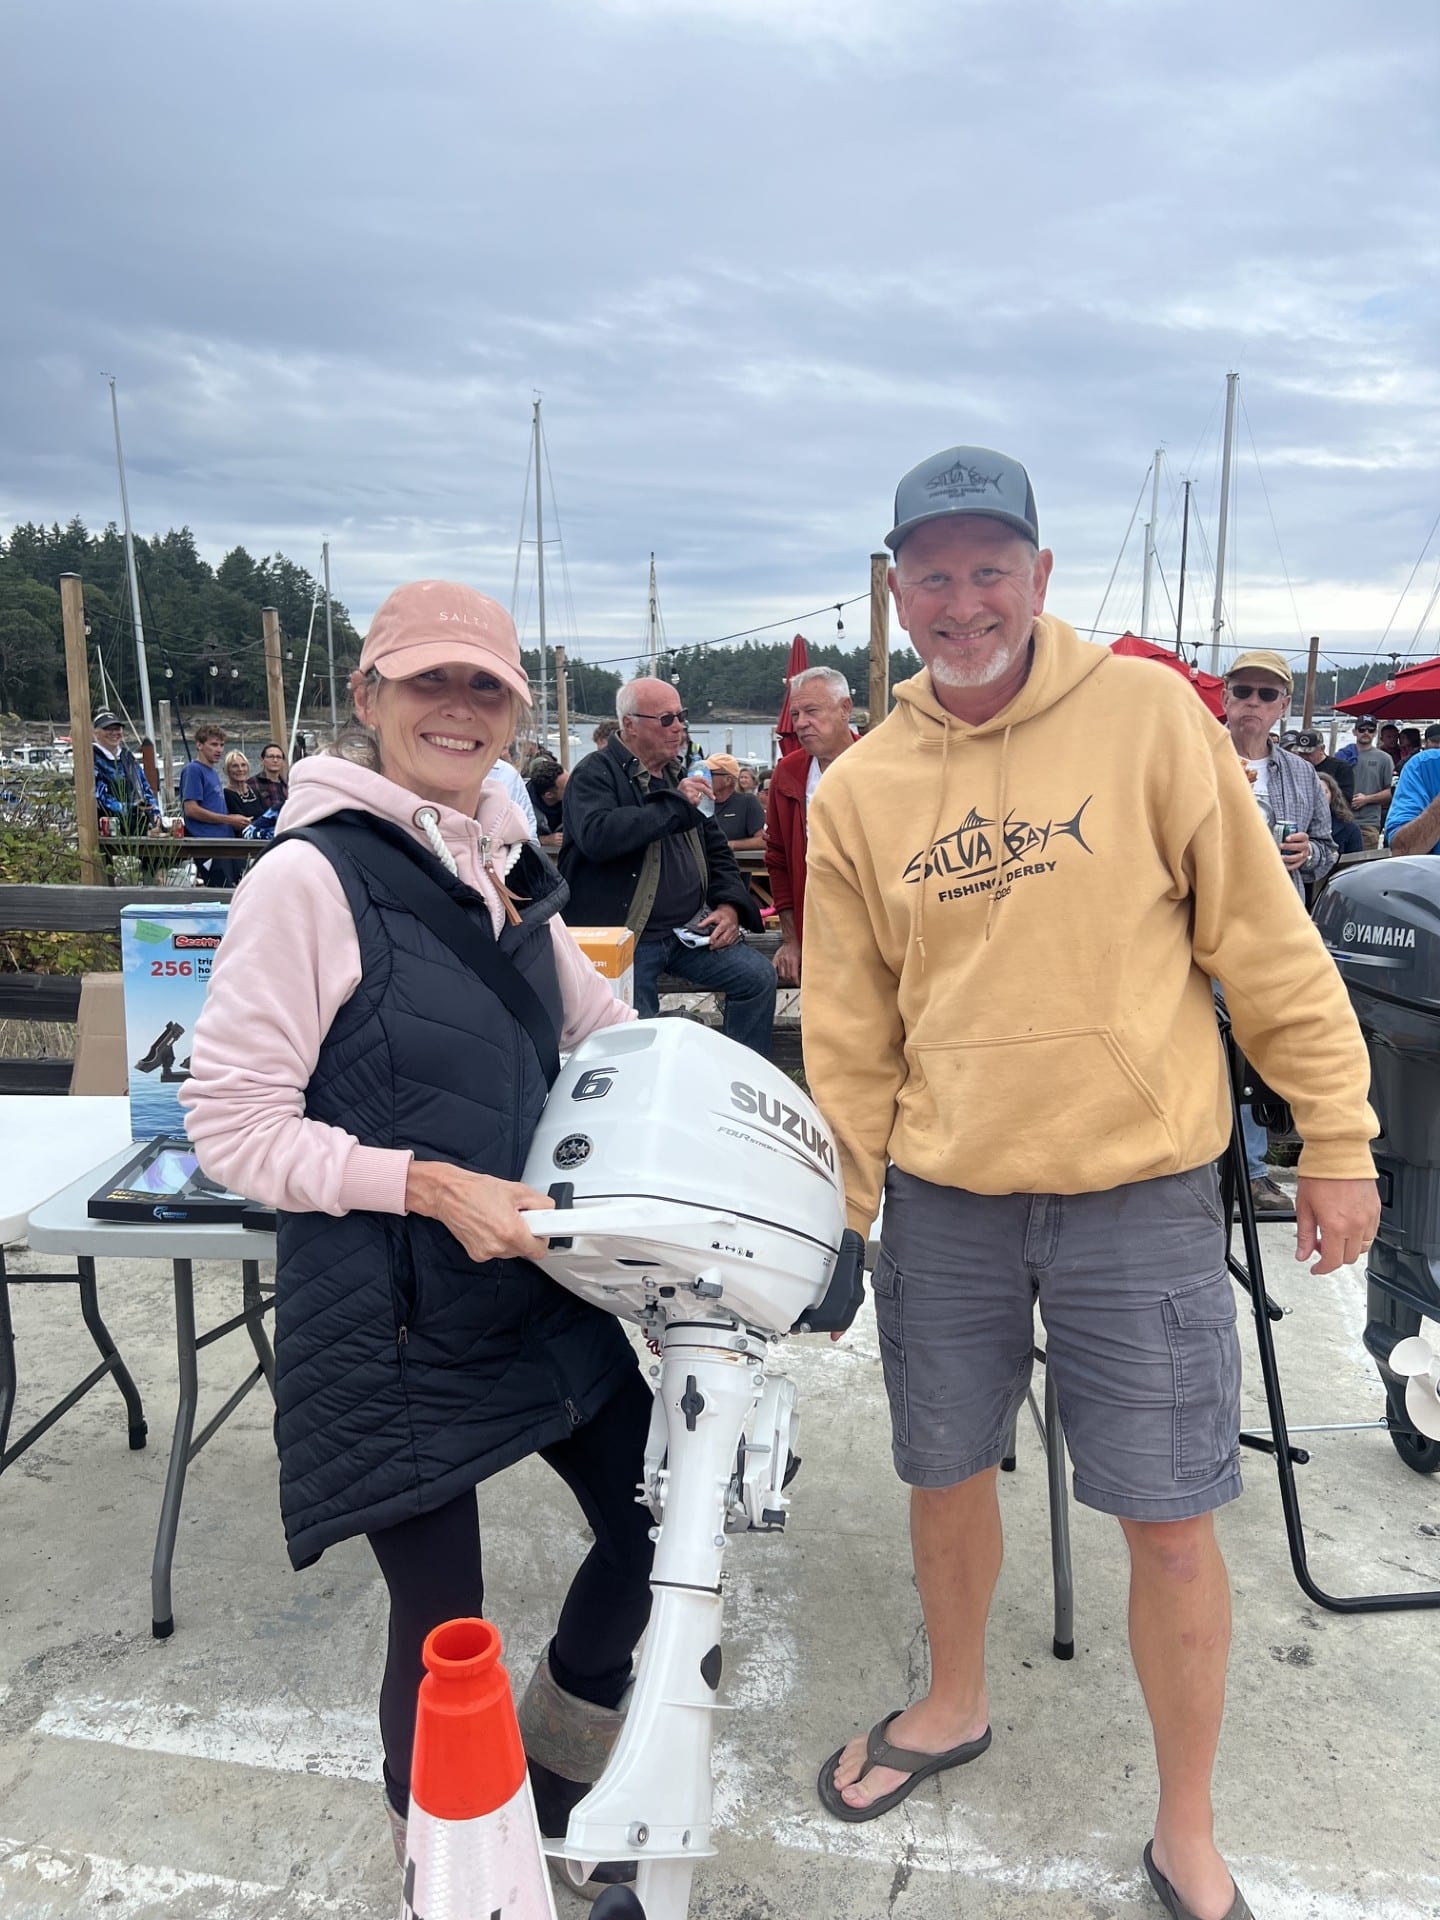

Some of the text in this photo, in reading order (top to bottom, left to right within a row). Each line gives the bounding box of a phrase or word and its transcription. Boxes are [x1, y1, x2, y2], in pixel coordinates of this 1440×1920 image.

[440, 612, 488, 630] SALTY
[1006, 861, 1057, 883] DERBY
[1356, 924, 1415, 948] YAMAHA
[151, 960, 193, 977] 256
[198, 966, 211, 974] ho
[571, 1066, 619, 1102] 6
[717, 1126, 751, 1141] FOUR
[730, 1081, 834, 1174] SUZUKI
